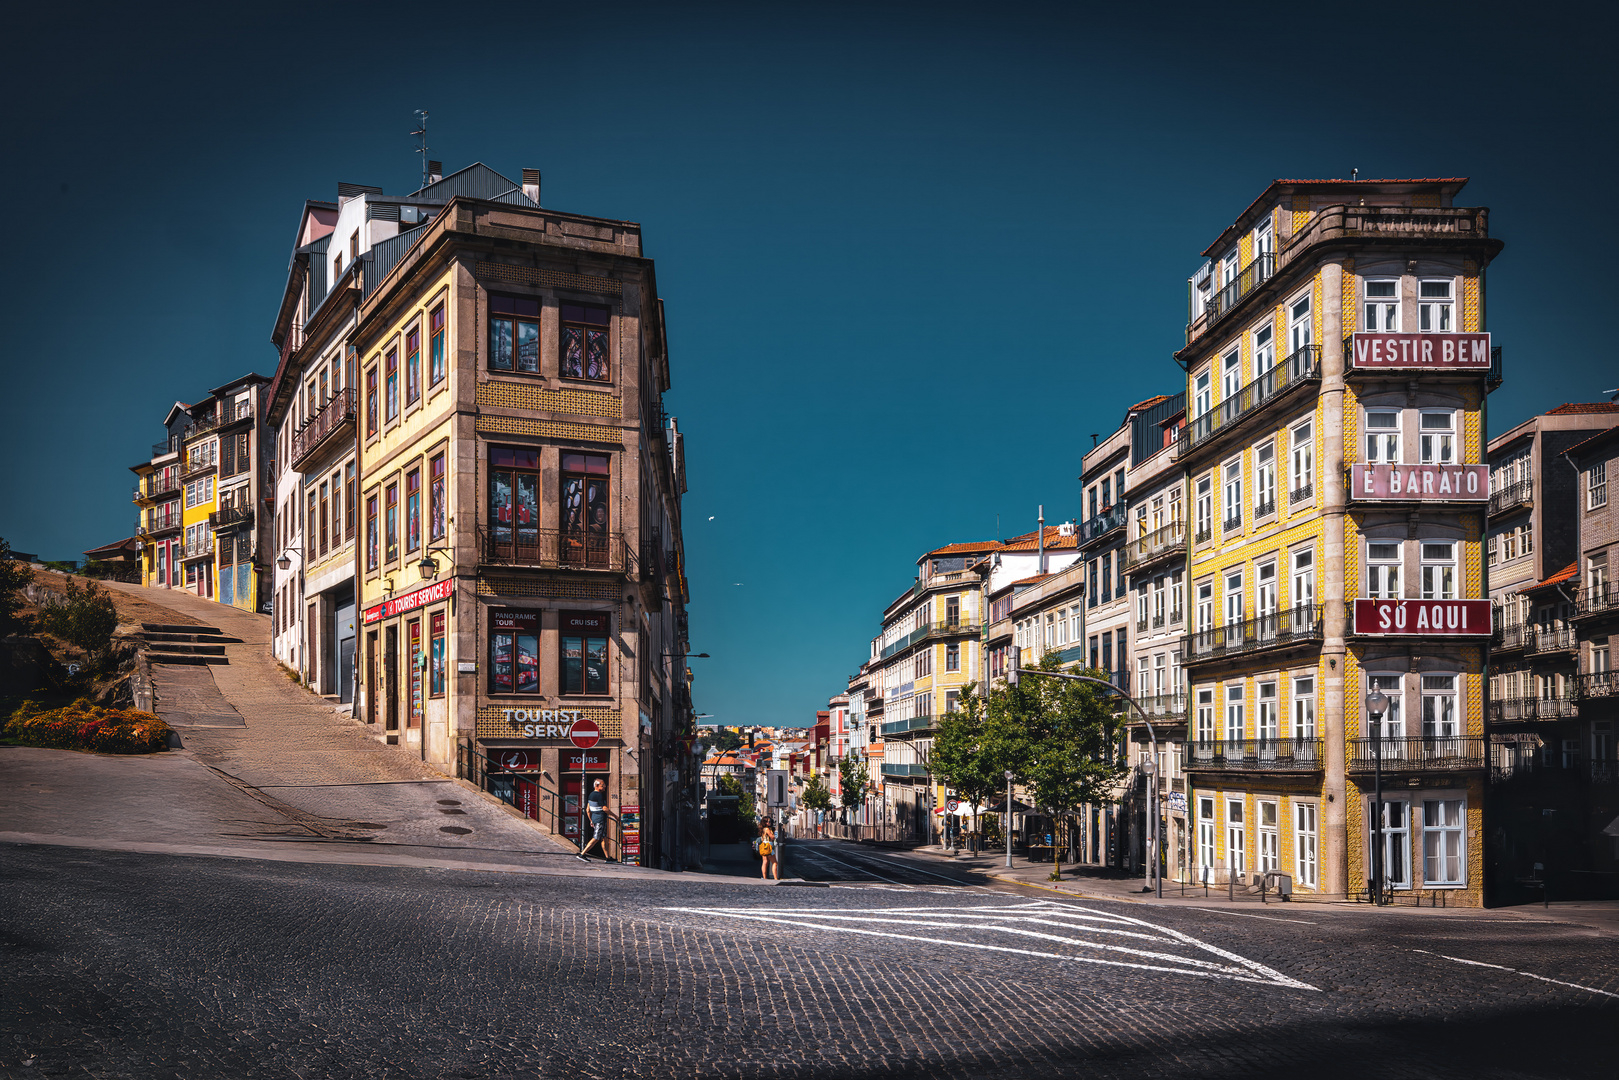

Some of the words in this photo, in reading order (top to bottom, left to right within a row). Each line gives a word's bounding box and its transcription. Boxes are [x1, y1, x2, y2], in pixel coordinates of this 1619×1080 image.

[1356, 339, 1434, 362] VESTIR
[1442, 339, 1487, 362] BEM
[1390, 470, 1478, 493] BARATO
[395, 594, 418, 612] TOURIST
[418, 583, 444, 605] SERVICE
[495, 612, 536, 620] PANORAMIC
[570, 618, 599, 626] CRUISES
[1379, 600, 1407, 629] SÓ
[1417, 606, 1467, 629] AQUI
[503, 709, 581, 723] TOURIST
